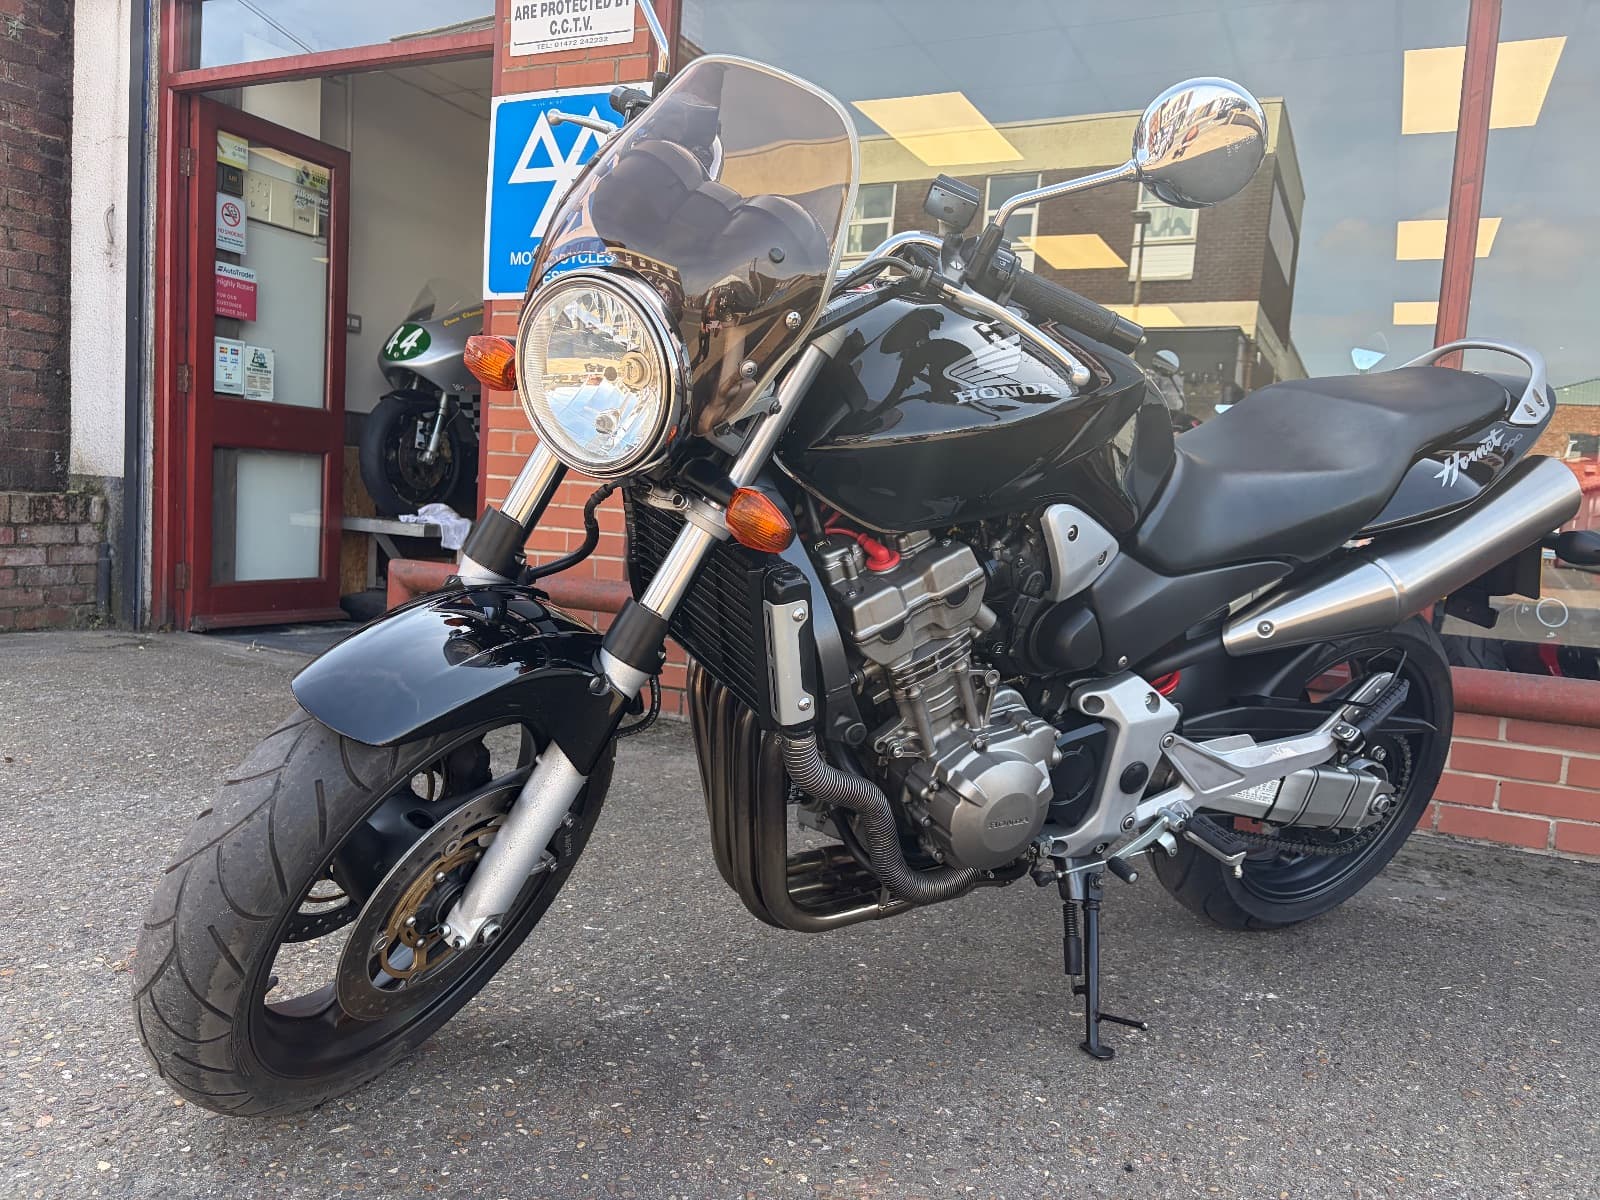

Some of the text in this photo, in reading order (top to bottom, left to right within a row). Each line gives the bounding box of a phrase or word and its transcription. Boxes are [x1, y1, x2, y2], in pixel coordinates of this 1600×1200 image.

[514, 4, 537, 21] ARE
[541, 0, 611, 17] PROTECTED
[550, 15, 593, 36] C.C.T.V.
[554, 39, 578, 48] 01472
[222, 266, 255, 280] AutoTrader
[216, 278, 235, 289] Highly
[952, 383, 1060, 404] HONDA
[1433, 427, 1524, 488] Hornet 900
[988, 816, 1030, 830] HONDA
